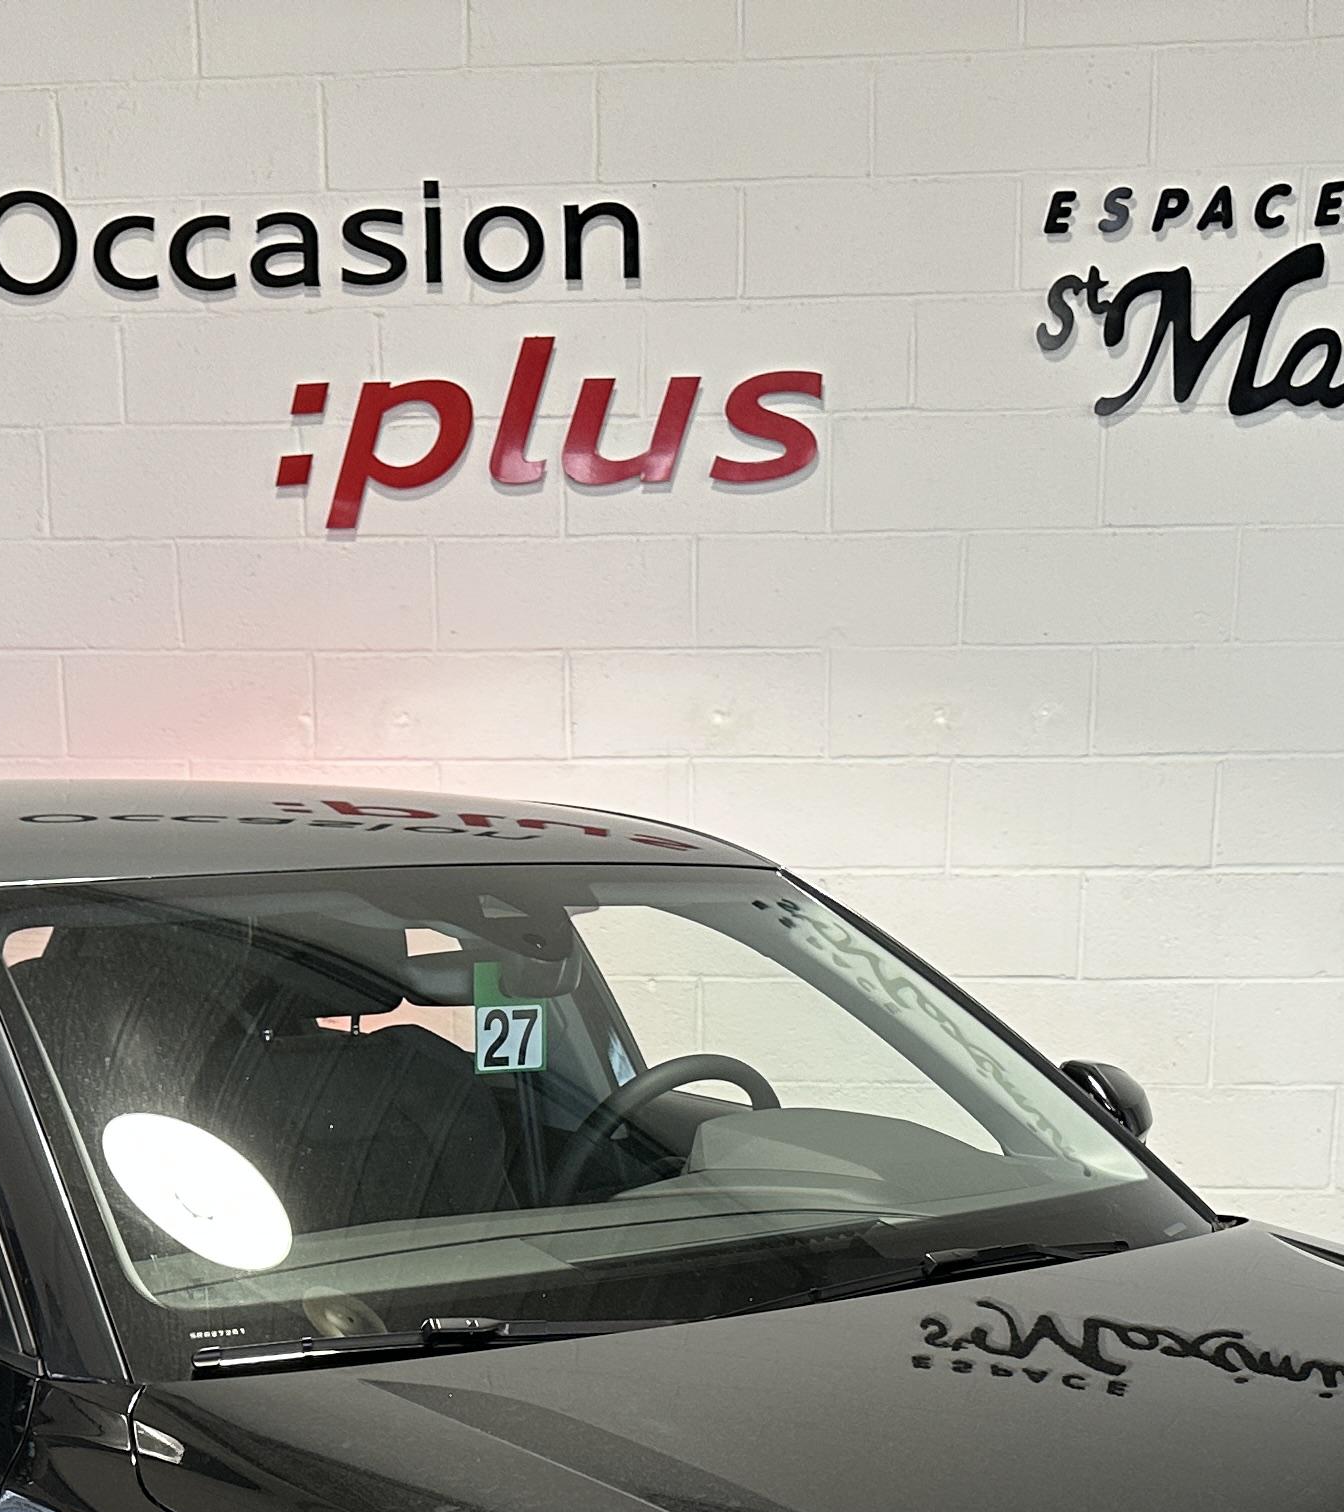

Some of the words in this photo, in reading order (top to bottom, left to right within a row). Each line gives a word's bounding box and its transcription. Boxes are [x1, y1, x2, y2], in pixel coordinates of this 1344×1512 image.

[1035, 265, 1109, 352] St
[275, 335, 825, 530] :plus
[483, 1008, 538, 1068] 27
